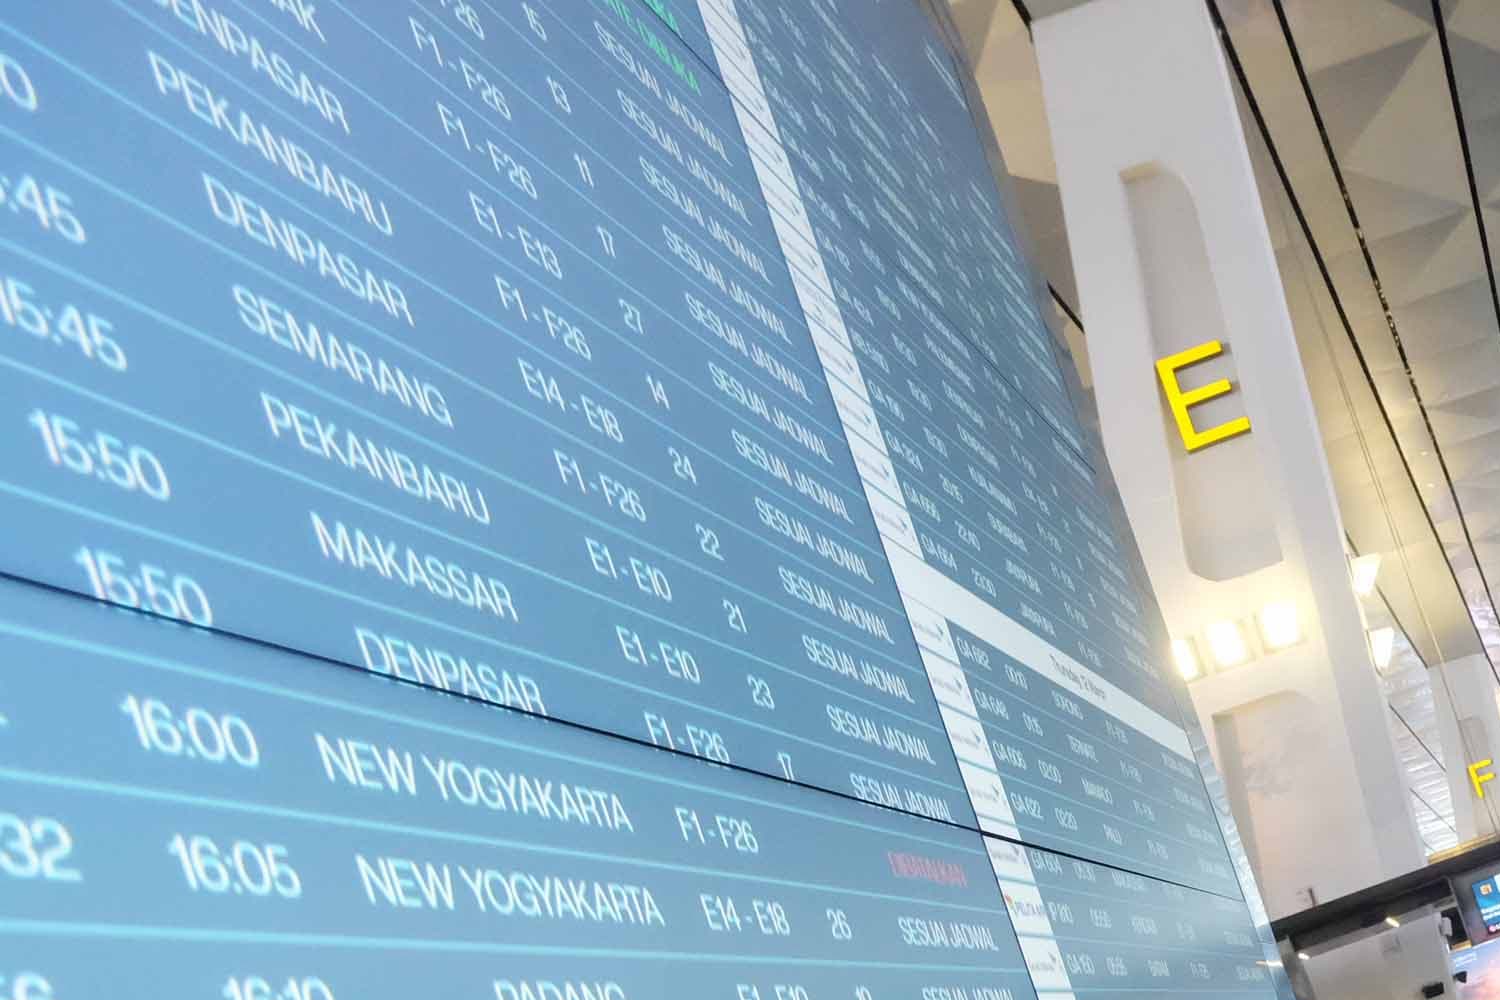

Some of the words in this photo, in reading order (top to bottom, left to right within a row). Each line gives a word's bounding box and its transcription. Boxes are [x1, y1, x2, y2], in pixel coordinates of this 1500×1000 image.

[147, 50, 393, 236] PEKANBARU
[646, 375, 670, 409] 14
[154, 0, 350, 134] ENPASAR
[618, 298, 644, 335] 27
[596, 225, 617, 259] 17
[202, 173, 415, 327] DENPASAR
[668, 446, 697, 485] 24
[231, 285, 454, 428] SEMARANG
[695, 523, 725, 561] 22
[1155, 339, 1251, 453] E
[29, 410, 171, 500] 15:50
[310, 511, 519, 622] MAKASSAR
[746, 674, 776, 710] 23
[260, 391, 491, 525] PEKANBARU
[722, 599, 748, 633] 21
[76, 547, 213, 627] 15:50
[355, 628, 549, 716] DENPASAR
[776, 751, 796, 781] 17
[849, 772, 905, 816] SESUAI
[904, 789, 958, 830] JADWAL
[121, 695, 259, 767] 16:00
[314, 733, 417, 795] NEW
[421, 755, 634, 833] YOGYAKARTA
[1468, 759, 1495, 797] F
[169, 834, 302, 898] 16:05
[355, 854, 455, 910] NEW
[458, 866, 665, 926] YOGYAKARTA
[826, 908, 852, 940] 26
[897, 916, 950, 947] SESUAI
[949, 922, 999, 951] JADWAL
